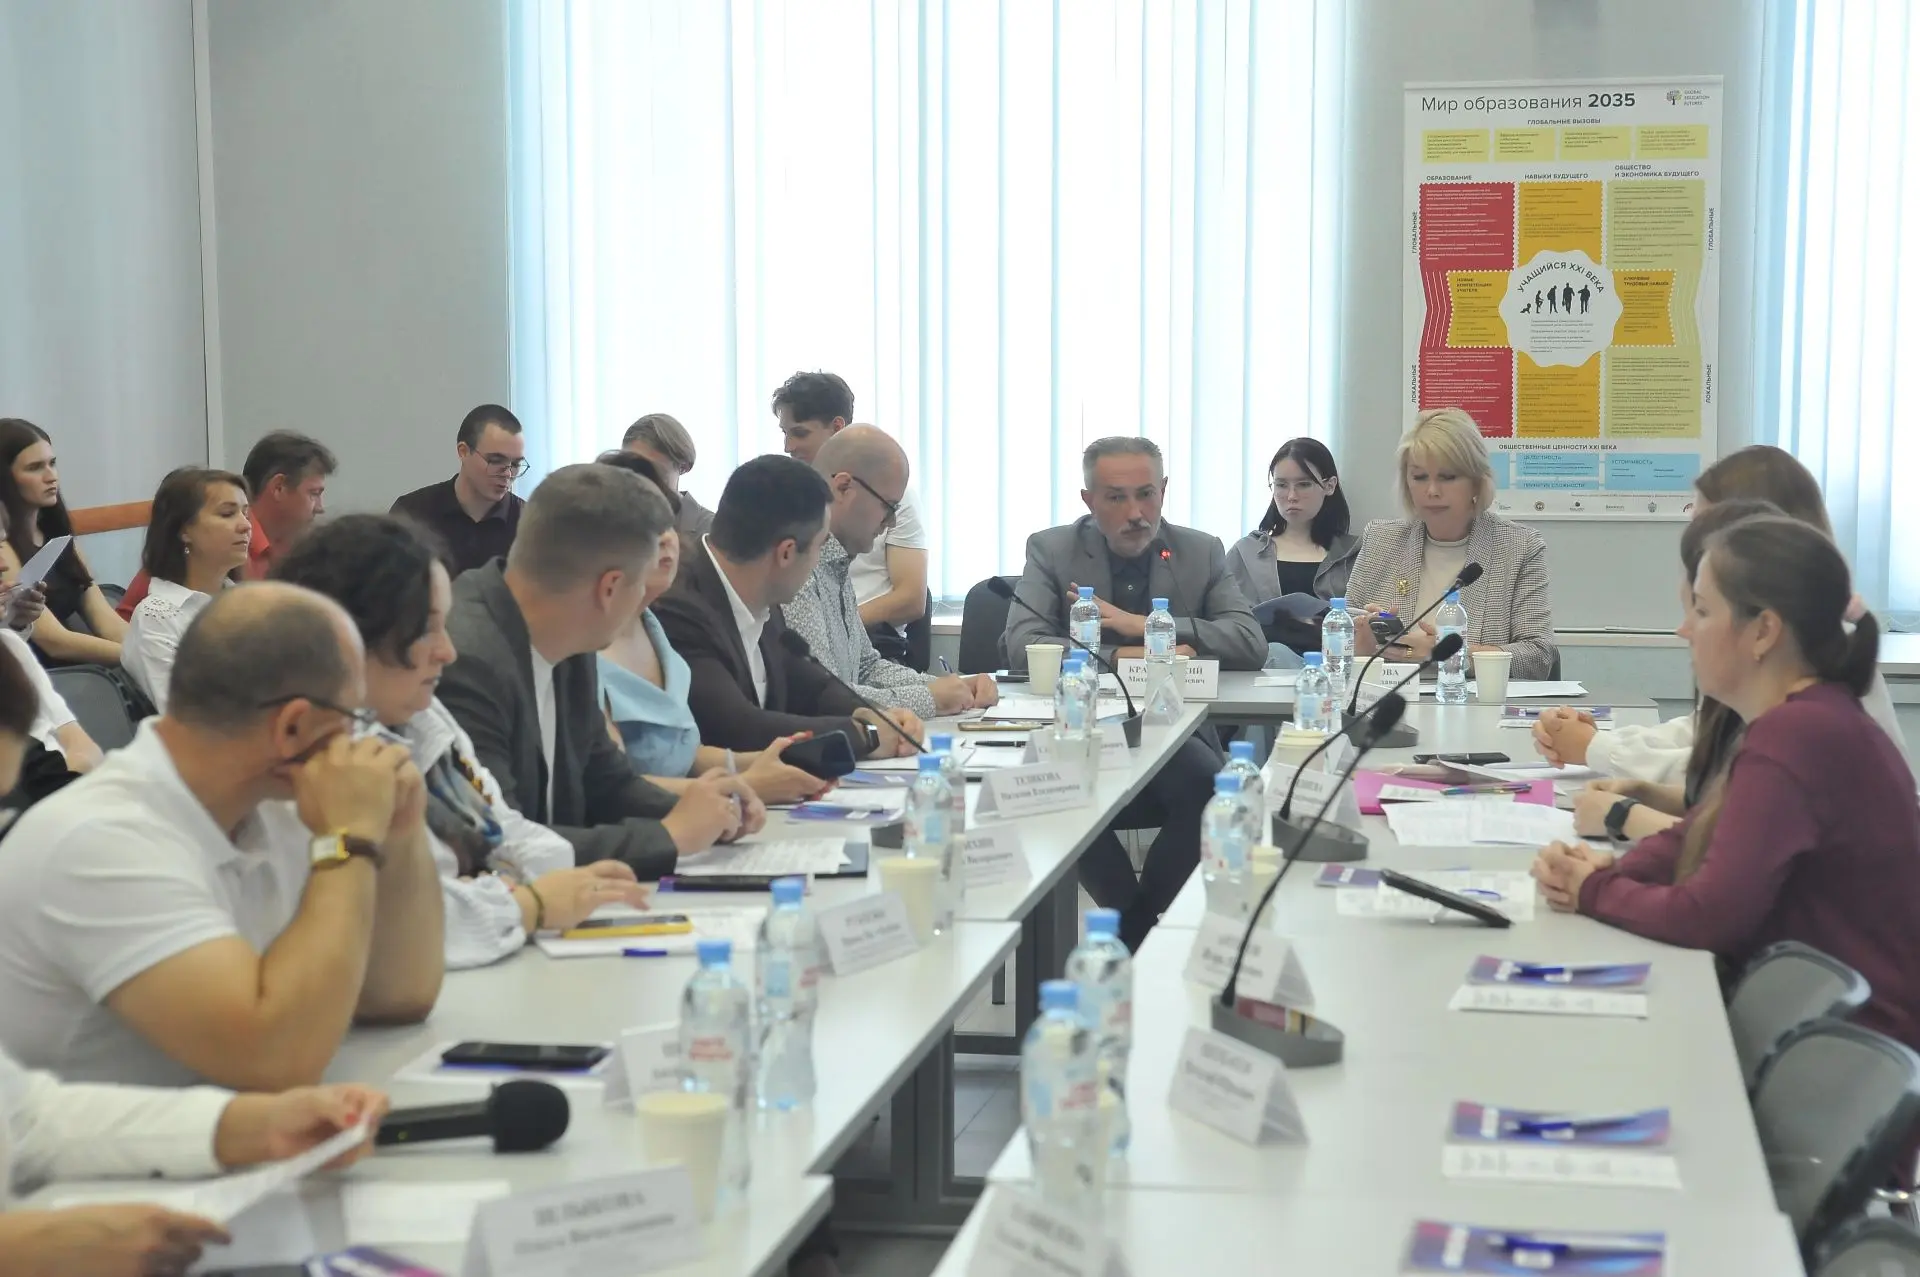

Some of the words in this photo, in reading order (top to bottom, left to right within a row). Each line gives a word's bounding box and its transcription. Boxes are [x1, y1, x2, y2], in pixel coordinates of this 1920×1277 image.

[1421, 96, 1458, 114] Мир
[1464, 94, 1582, 113] образования
[1588, 92, 1636, 107] 2035
[1553, 172, 1589, 181] БУДУЩЕГО
[1664, 170, 1700, 178] БУДУЩЕГО
[1517, 261, 1567, 293] УЧАЩИЙСЯ
[1585, 271, 1605, 293] ВЕКА
